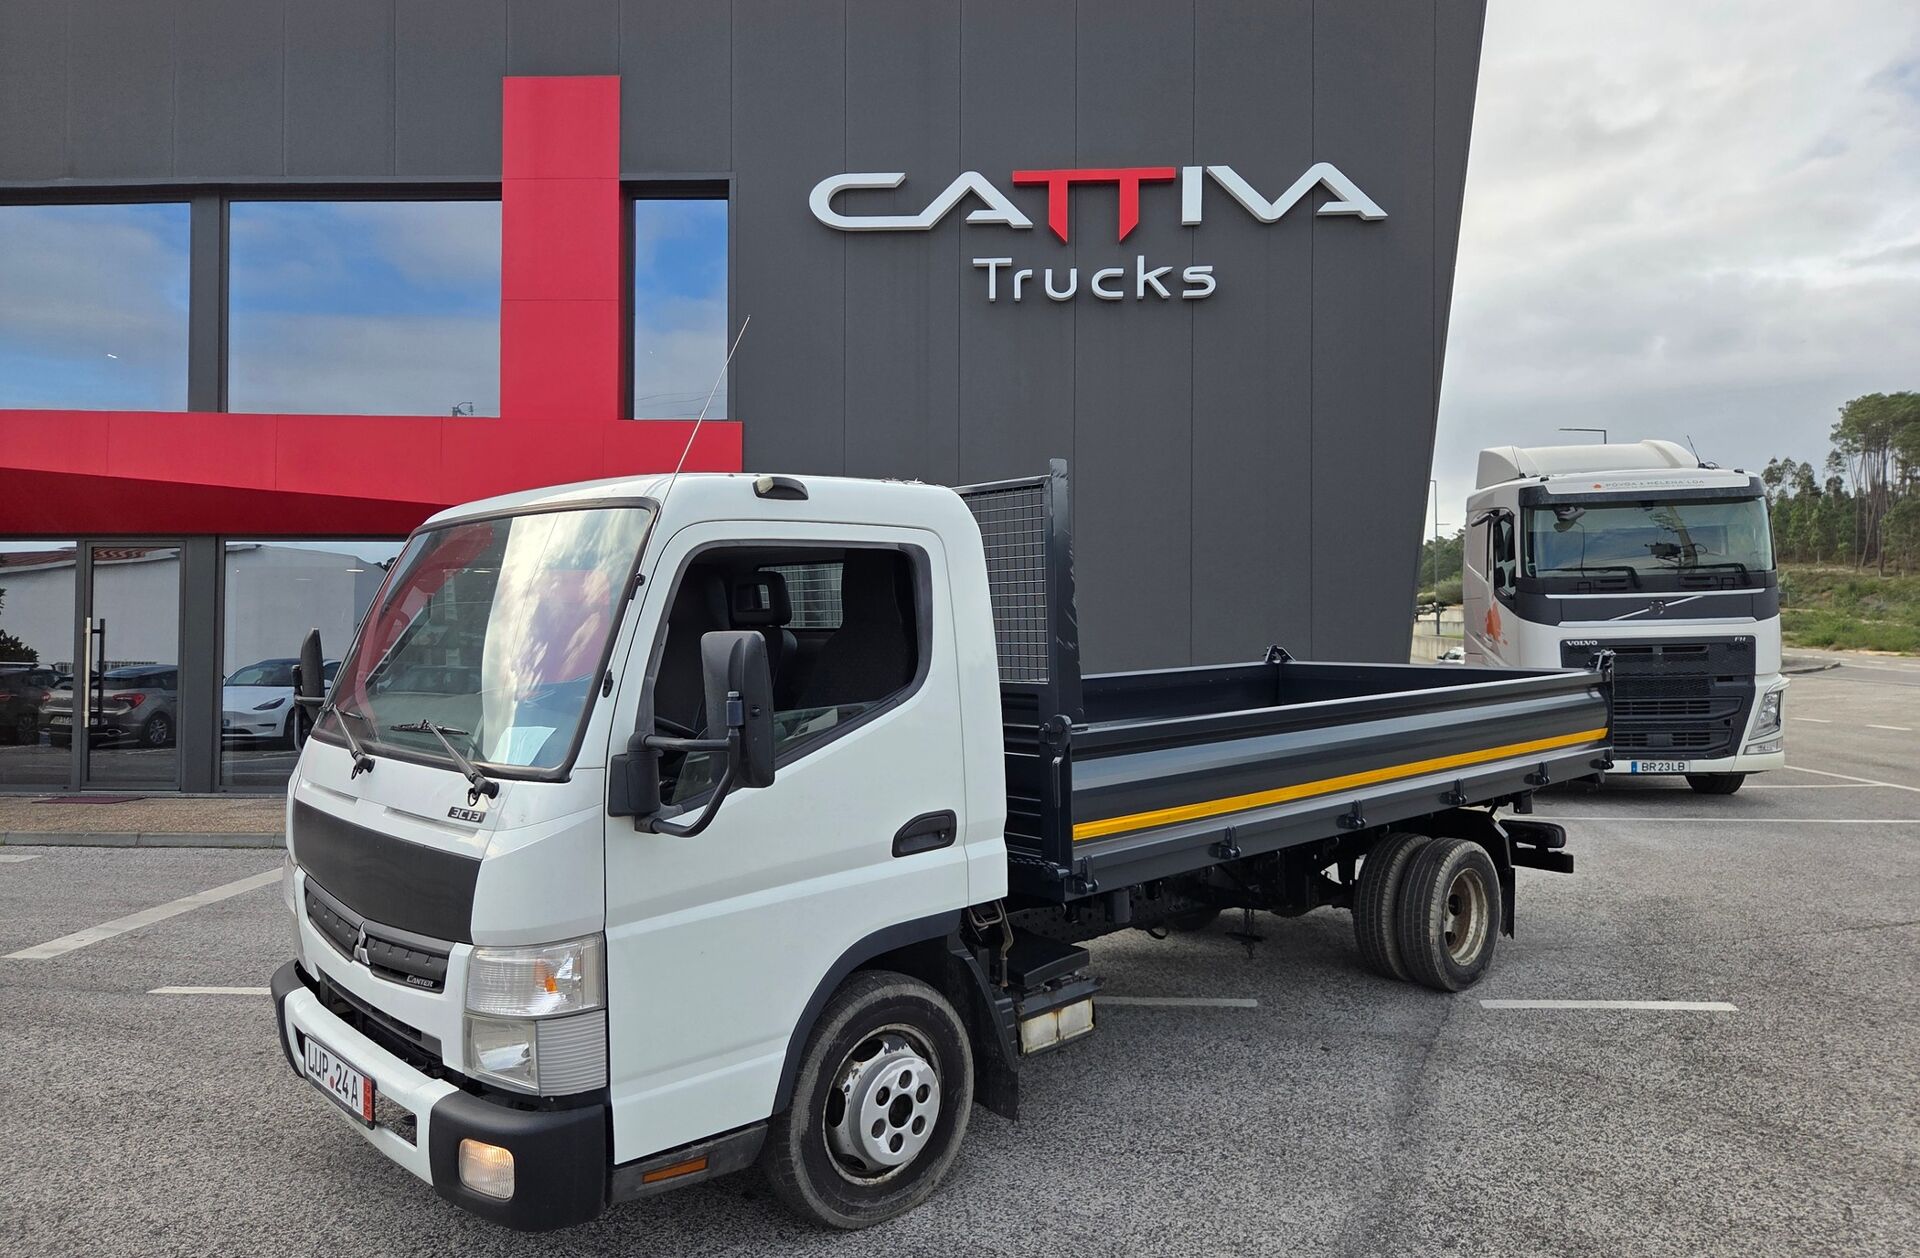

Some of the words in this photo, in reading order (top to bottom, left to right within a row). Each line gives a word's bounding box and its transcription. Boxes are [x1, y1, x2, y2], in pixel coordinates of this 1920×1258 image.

[809, 162, 1388, 244] CATTIVA
[973, 255, 1217, 302] Trucks
[451, 808, 481, 821] 3C13
[308, 1042, 329, 1081] LUP
